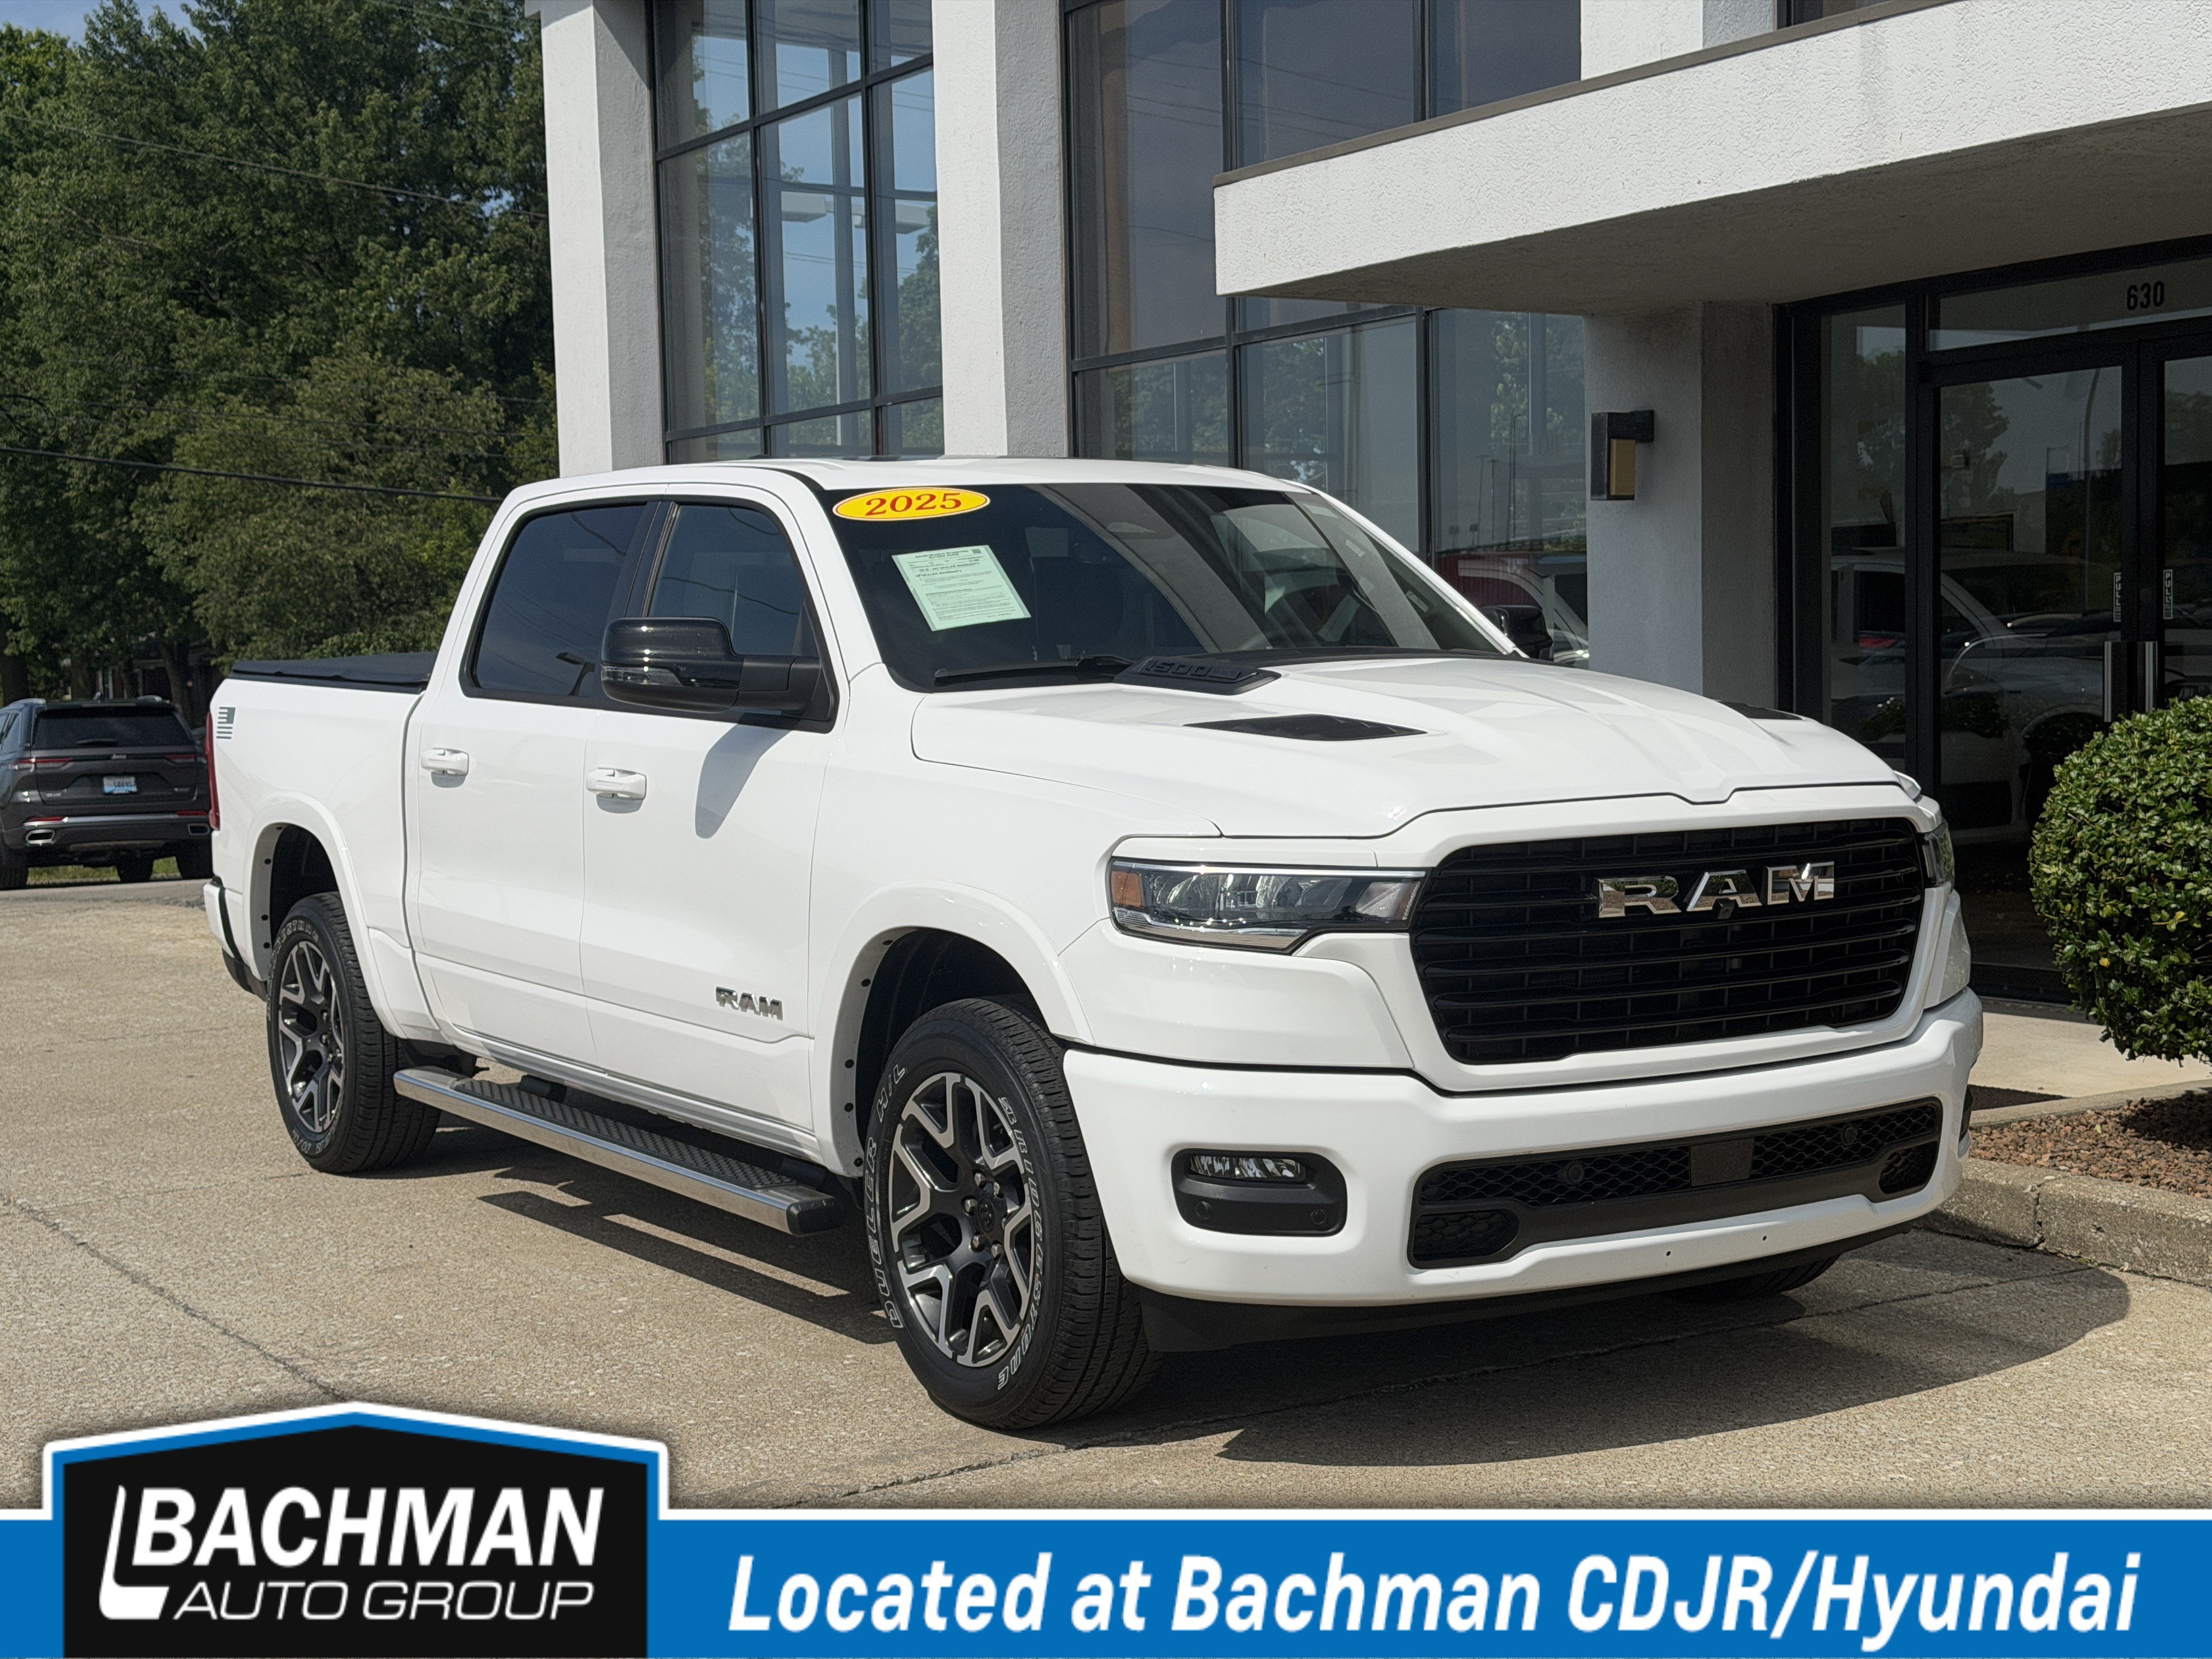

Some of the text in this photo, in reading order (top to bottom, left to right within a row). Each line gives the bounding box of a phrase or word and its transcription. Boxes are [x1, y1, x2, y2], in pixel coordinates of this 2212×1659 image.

[2126, 280, 2165, 311] 630
[865, 492, 962, 517] 2025
[1145, 660, 1212, 676] 1500
[1597, 861, 1835, 918] RAM
[715, 986, 783, 1021] RAM
[865, 1137, 904, 1328] DUELER
[997, 1097, 1043, 1391] BRIDGESTONE
